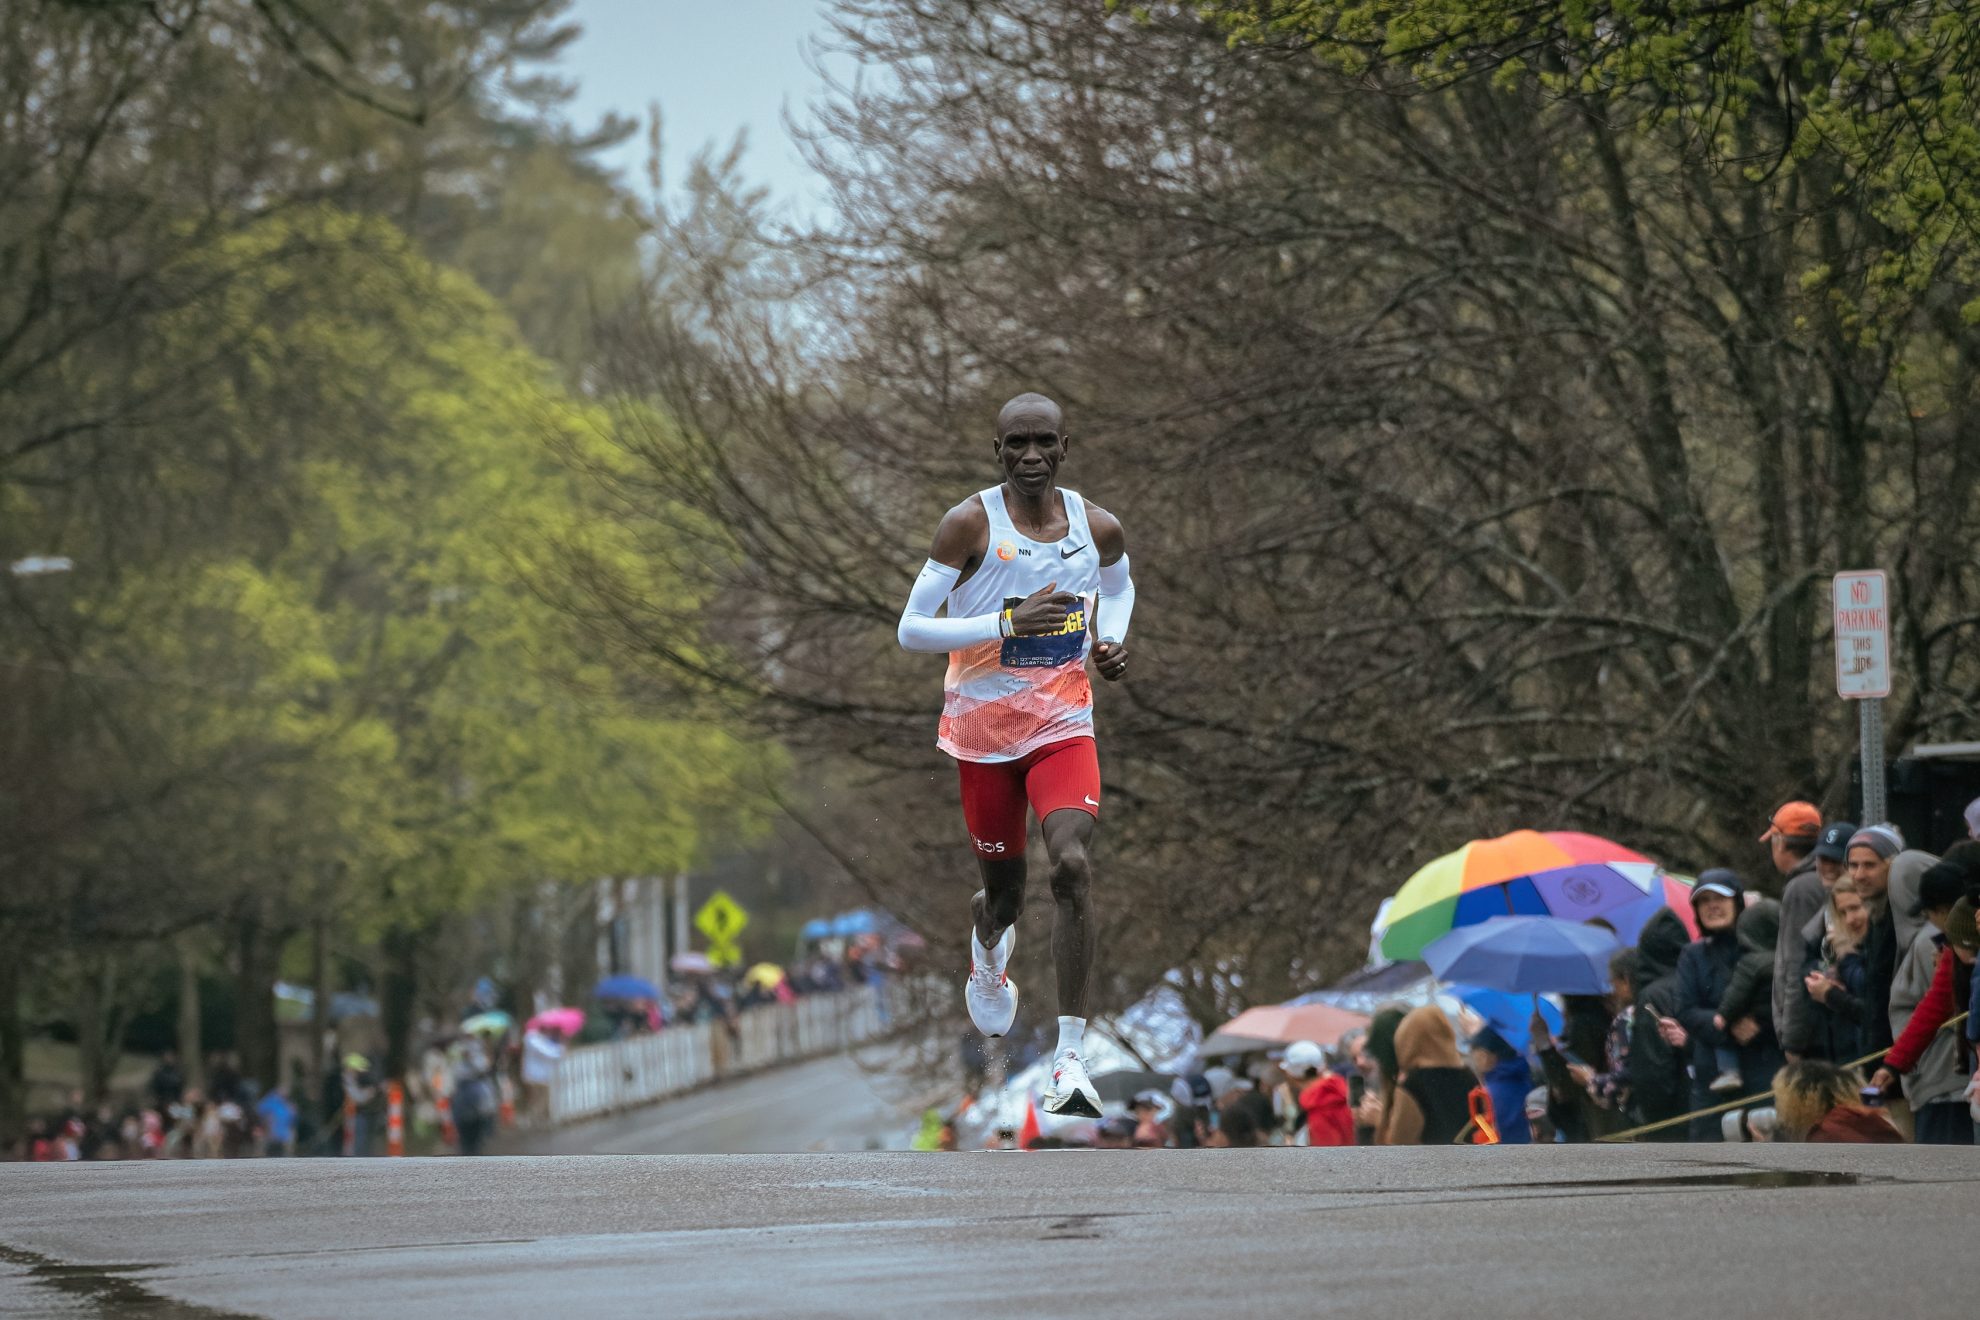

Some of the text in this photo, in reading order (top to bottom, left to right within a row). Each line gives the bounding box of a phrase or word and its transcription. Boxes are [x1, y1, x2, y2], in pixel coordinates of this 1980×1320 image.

[1018, 548, 1032, 556] NN
[1850, 582, 1869, 604] NO
[1840, 609, 1883, 631] PARKING
[1852, 637, 1872, 651] THIS
